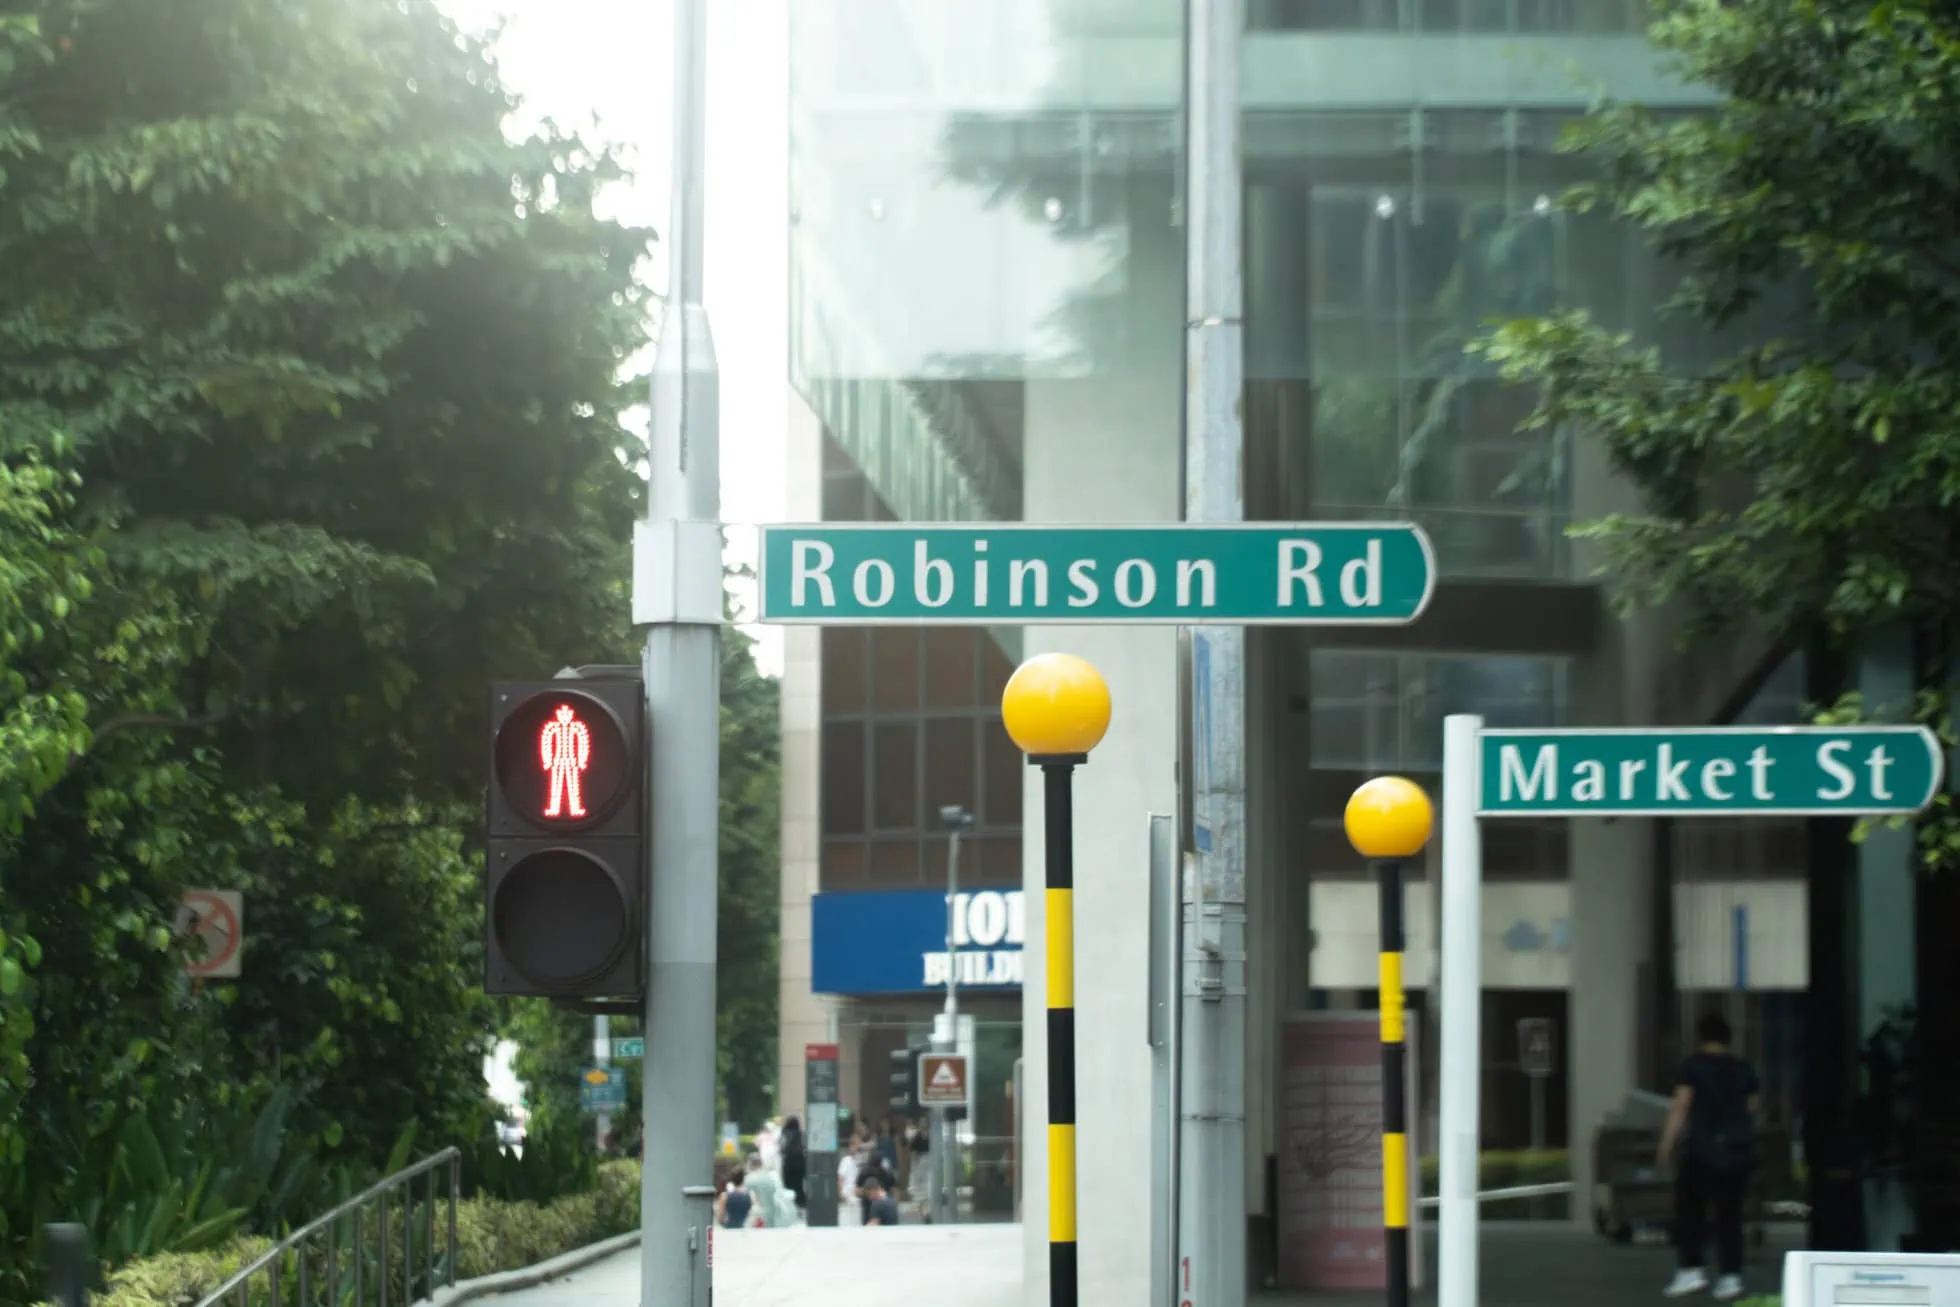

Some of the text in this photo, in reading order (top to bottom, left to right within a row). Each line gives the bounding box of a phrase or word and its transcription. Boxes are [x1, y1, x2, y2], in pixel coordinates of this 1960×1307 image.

[791, 538, 1382, 608] Robinson Rd
[1499, 740, 1894, 802] Market St
